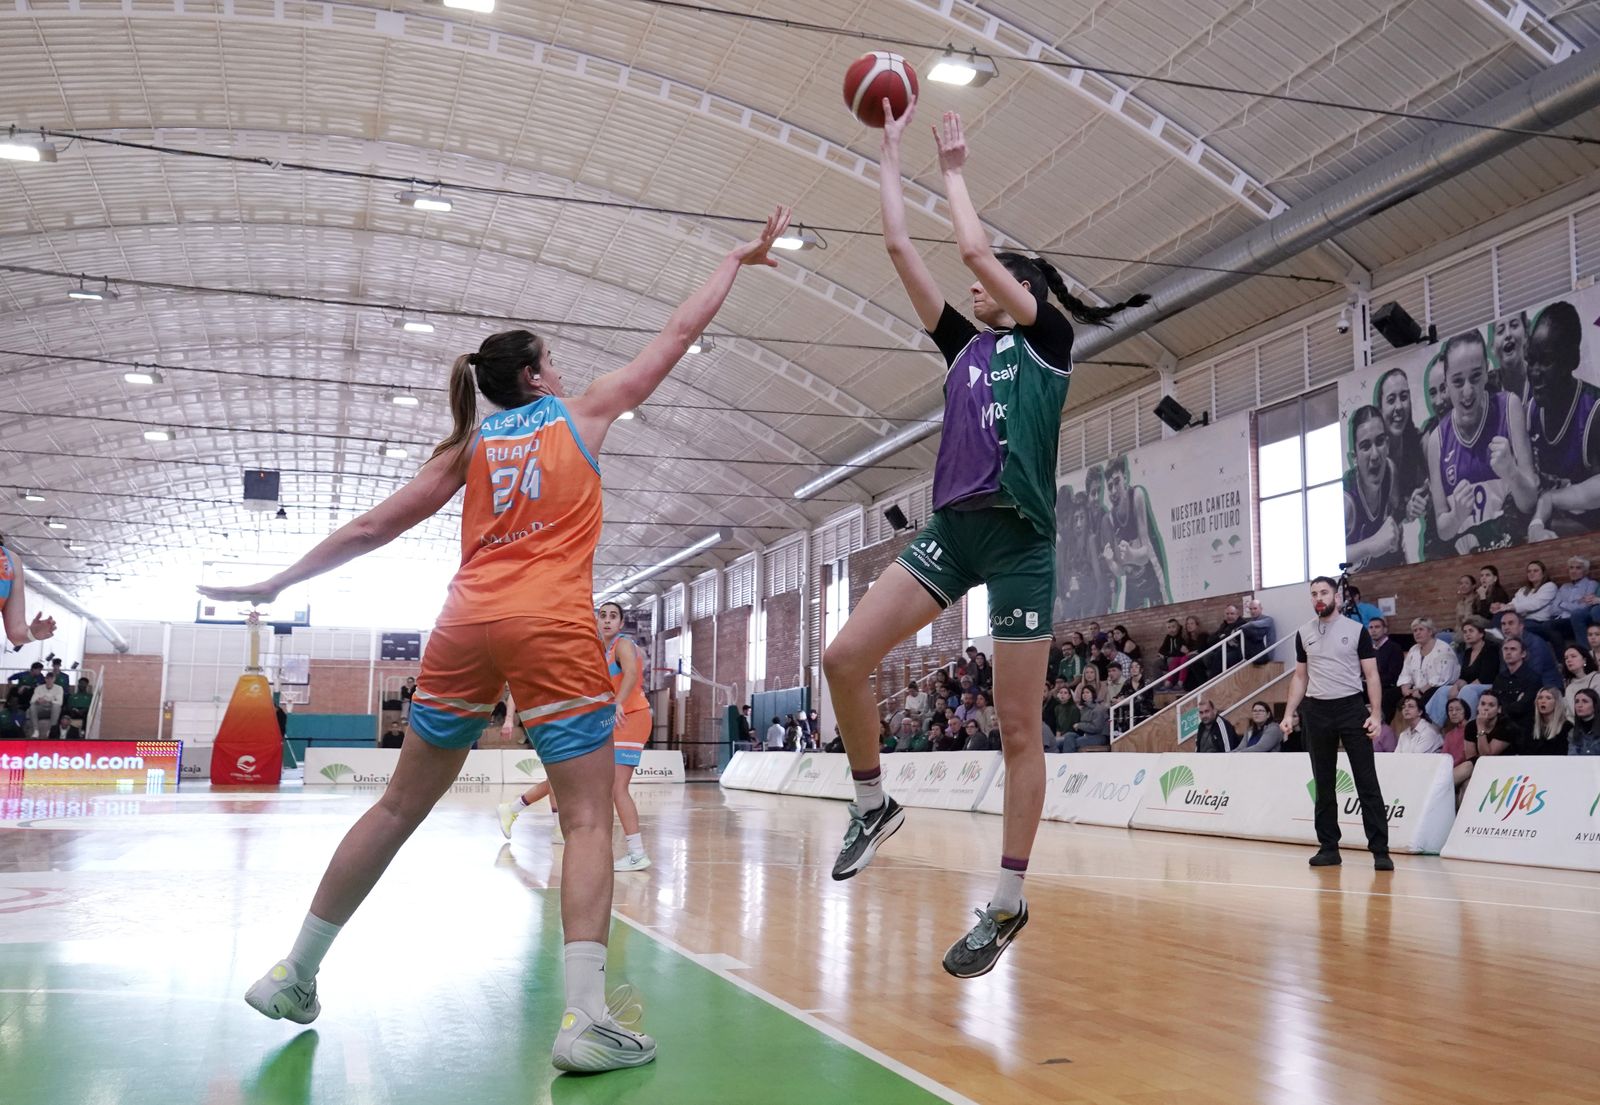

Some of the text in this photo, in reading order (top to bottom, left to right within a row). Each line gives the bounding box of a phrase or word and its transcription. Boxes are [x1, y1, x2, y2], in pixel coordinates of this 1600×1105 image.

[491, 457, 541, 514] 24
[1171, 490, 1241, 523] NUESTRA CANTERA
[1172, 508, 1240, 541] NUESTRO FUTURO
[353, 773, 391, 785] Unicaj
[635, 767, 673, 776] Unicaja
[1185, 789, 1230, 811] Unicaja
[1478, 775, 1548, 822] Mijas
[1464, 826, 1538, 838] AYUNTAMIENTO
